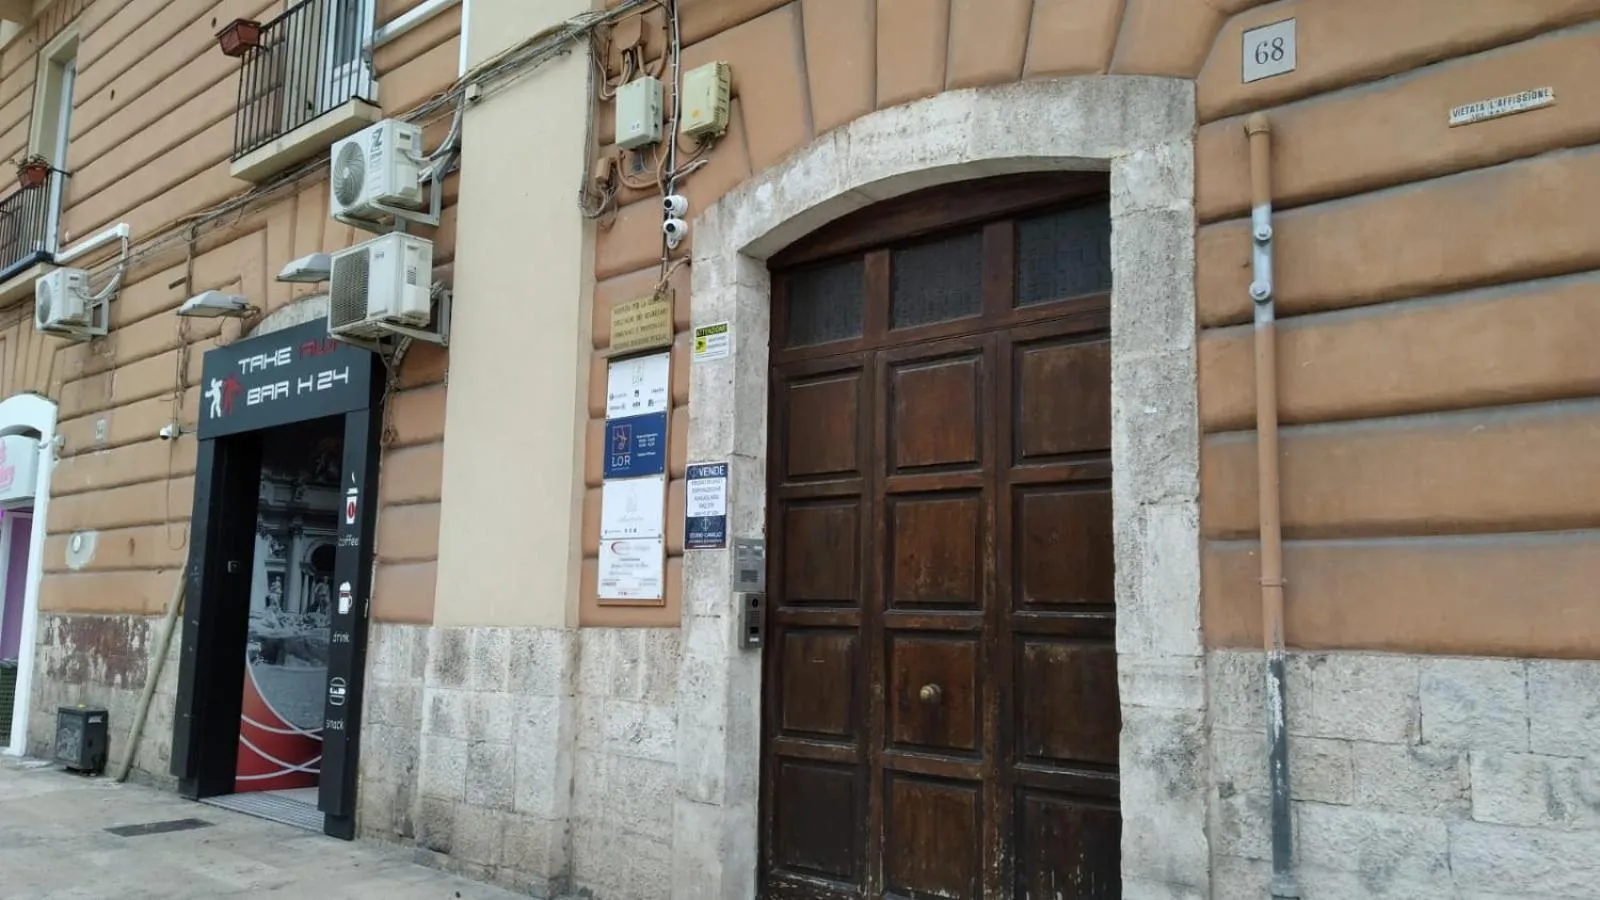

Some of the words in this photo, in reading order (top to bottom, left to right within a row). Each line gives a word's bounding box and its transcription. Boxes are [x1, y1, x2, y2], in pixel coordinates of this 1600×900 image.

[1255, 36, 1284, 65] 68
[1452, 102, 1485, 118] VIETATA
[1490, 88, 1550, 109] L'AFFISSIONE
[238, 346, 292, 375] TAKE
[246, 380, 290, 406] BAR
[611, 455, 631, 467] LOR
[698, 465, 725, 477] VENDE
[338, 534, 359, 546] coffee
[332, 630, 350, 643] drink
[326, 717, 344, 730] snack
